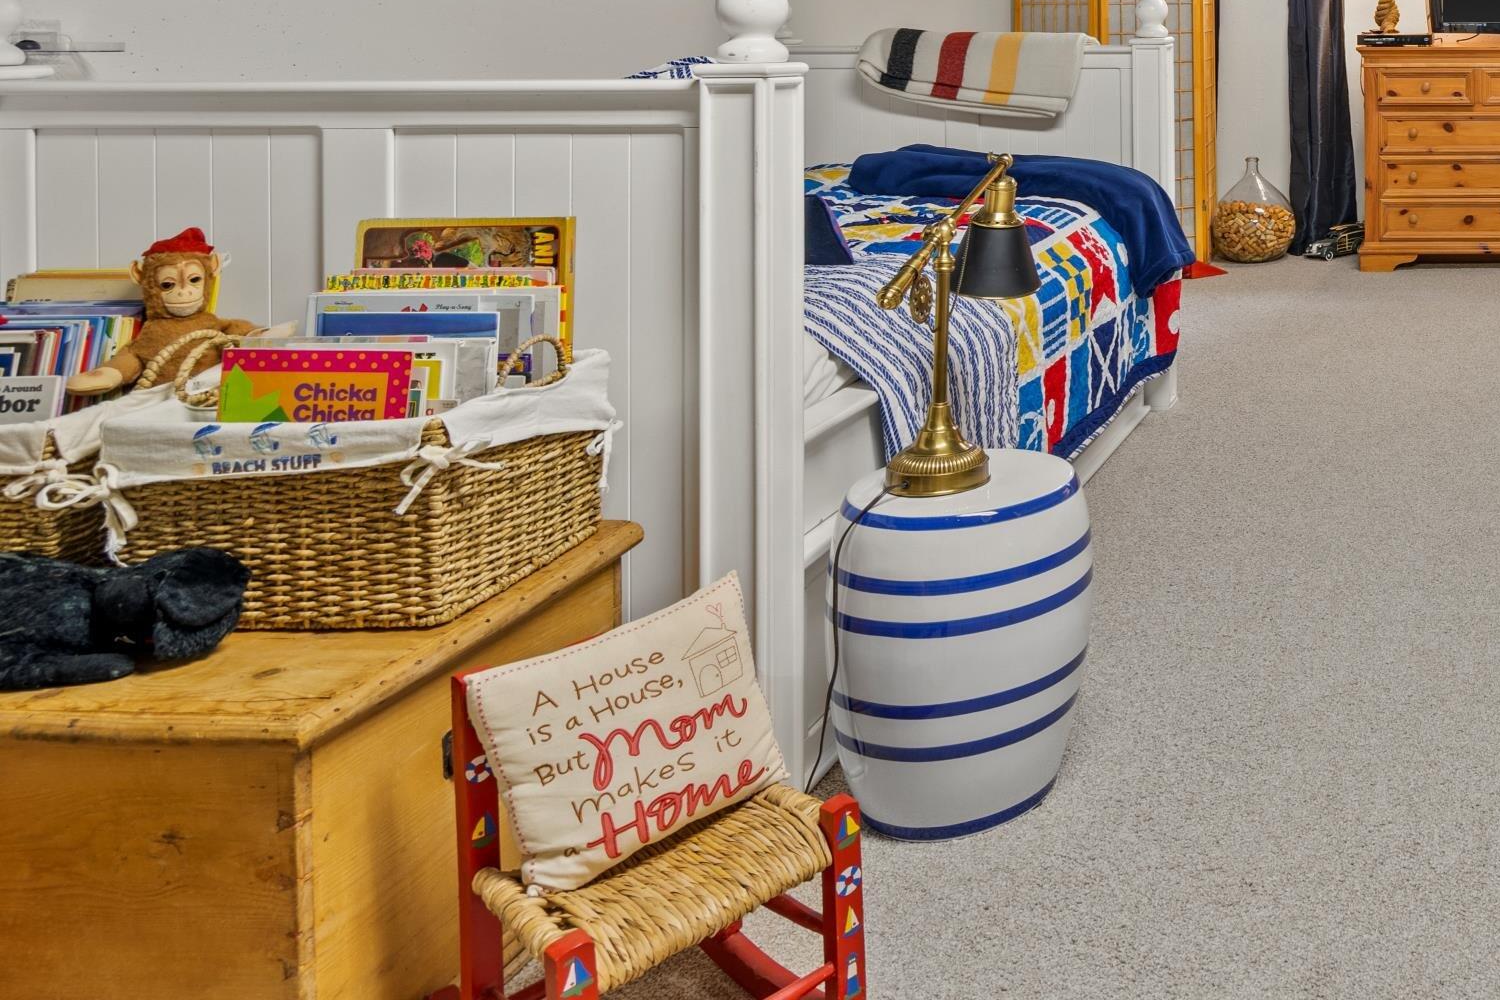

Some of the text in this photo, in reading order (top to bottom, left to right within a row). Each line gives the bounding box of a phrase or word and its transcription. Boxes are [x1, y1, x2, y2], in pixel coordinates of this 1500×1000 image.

[2, 384, 43, 393] Around
[294, 382, 377, 403] Chicka
[211, 453, 322, 475] BEACH STUFF
[531, 650, 665, 717] A House
[526, 672, 683, 746] is a House,
[533, 693, 748, 792] But Mom
[571, 728, 742, 823] makes it
[563, 846, 580, 858] a
